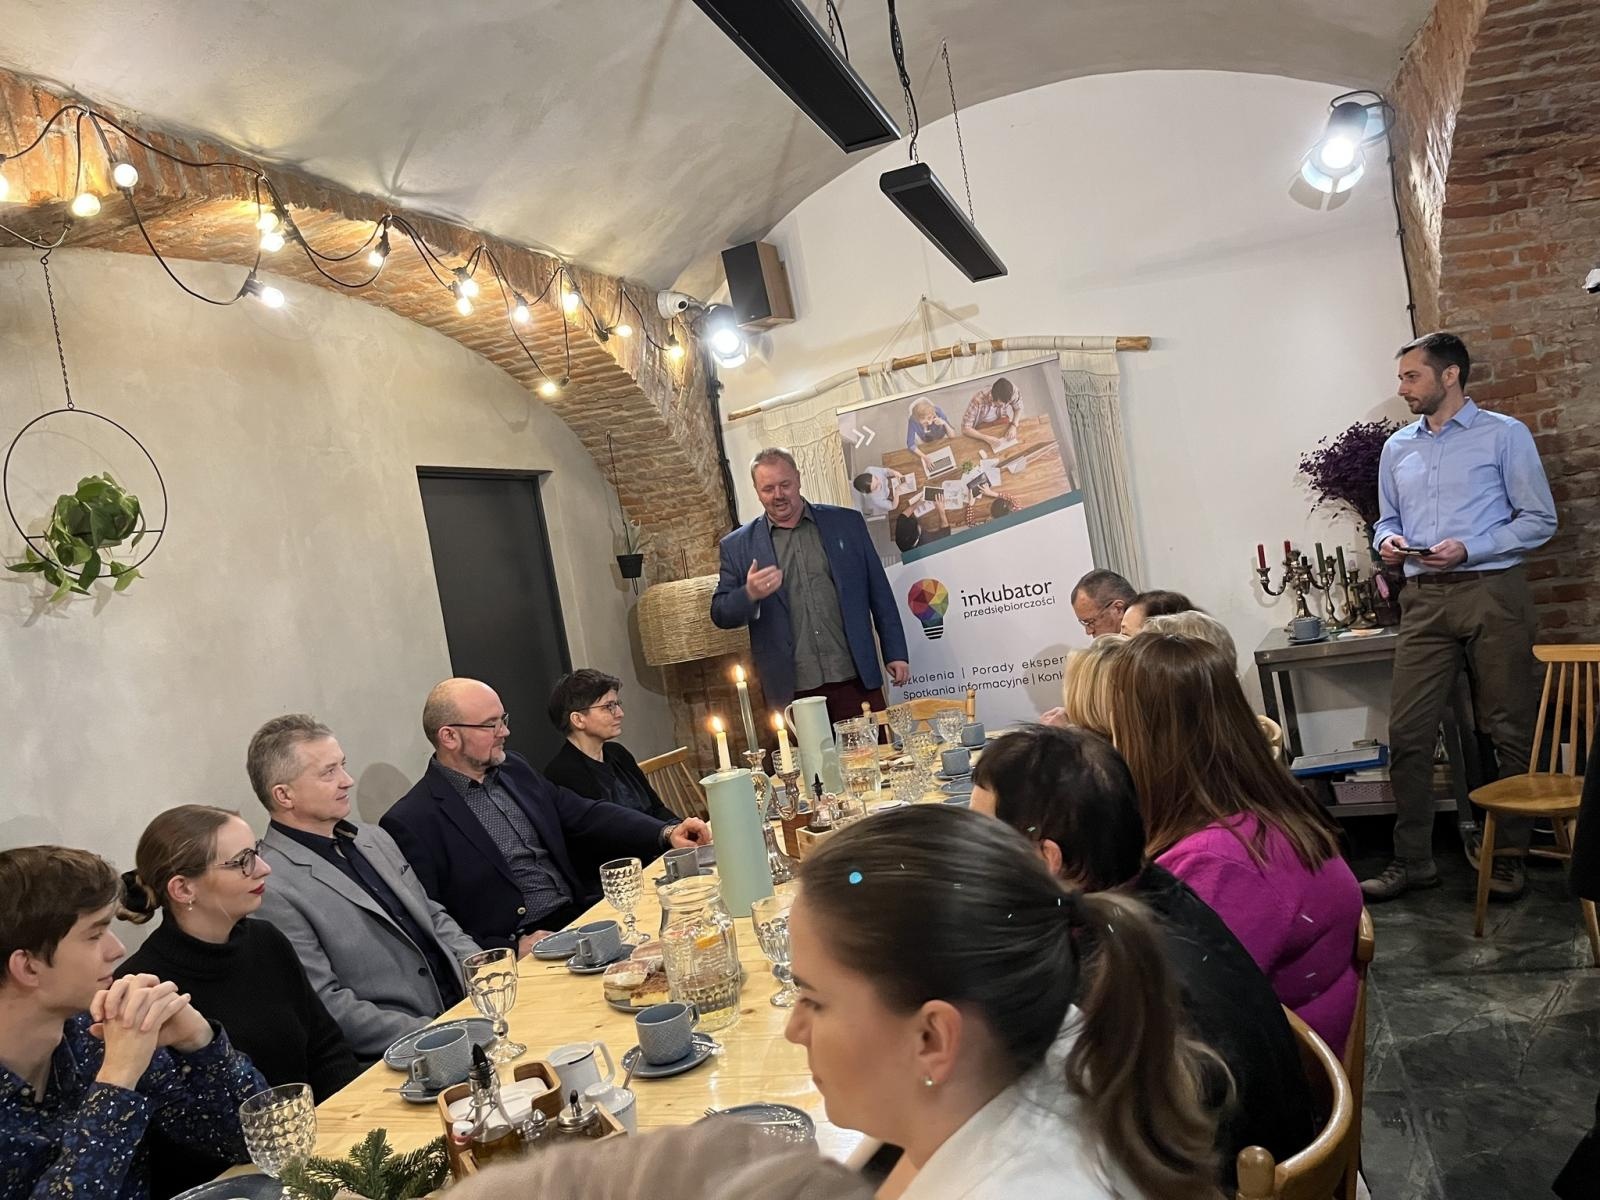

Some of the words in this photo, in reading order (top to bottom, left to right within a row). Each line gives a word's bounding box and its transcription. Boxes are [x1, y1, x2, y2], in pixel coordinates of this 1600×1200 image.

[960, 581, 1052, 607] inkubator
[963, 596, 1056, 619] przedsiębiorczości
[902, 670, 955, 686] zkolenia
[972, 662, 1014, 676] Porady
[1021, 655, 1068, 669] eksper
[903, 685, 956, 700] Spotkania
[958, 676, 1030, 693] informacyjne
